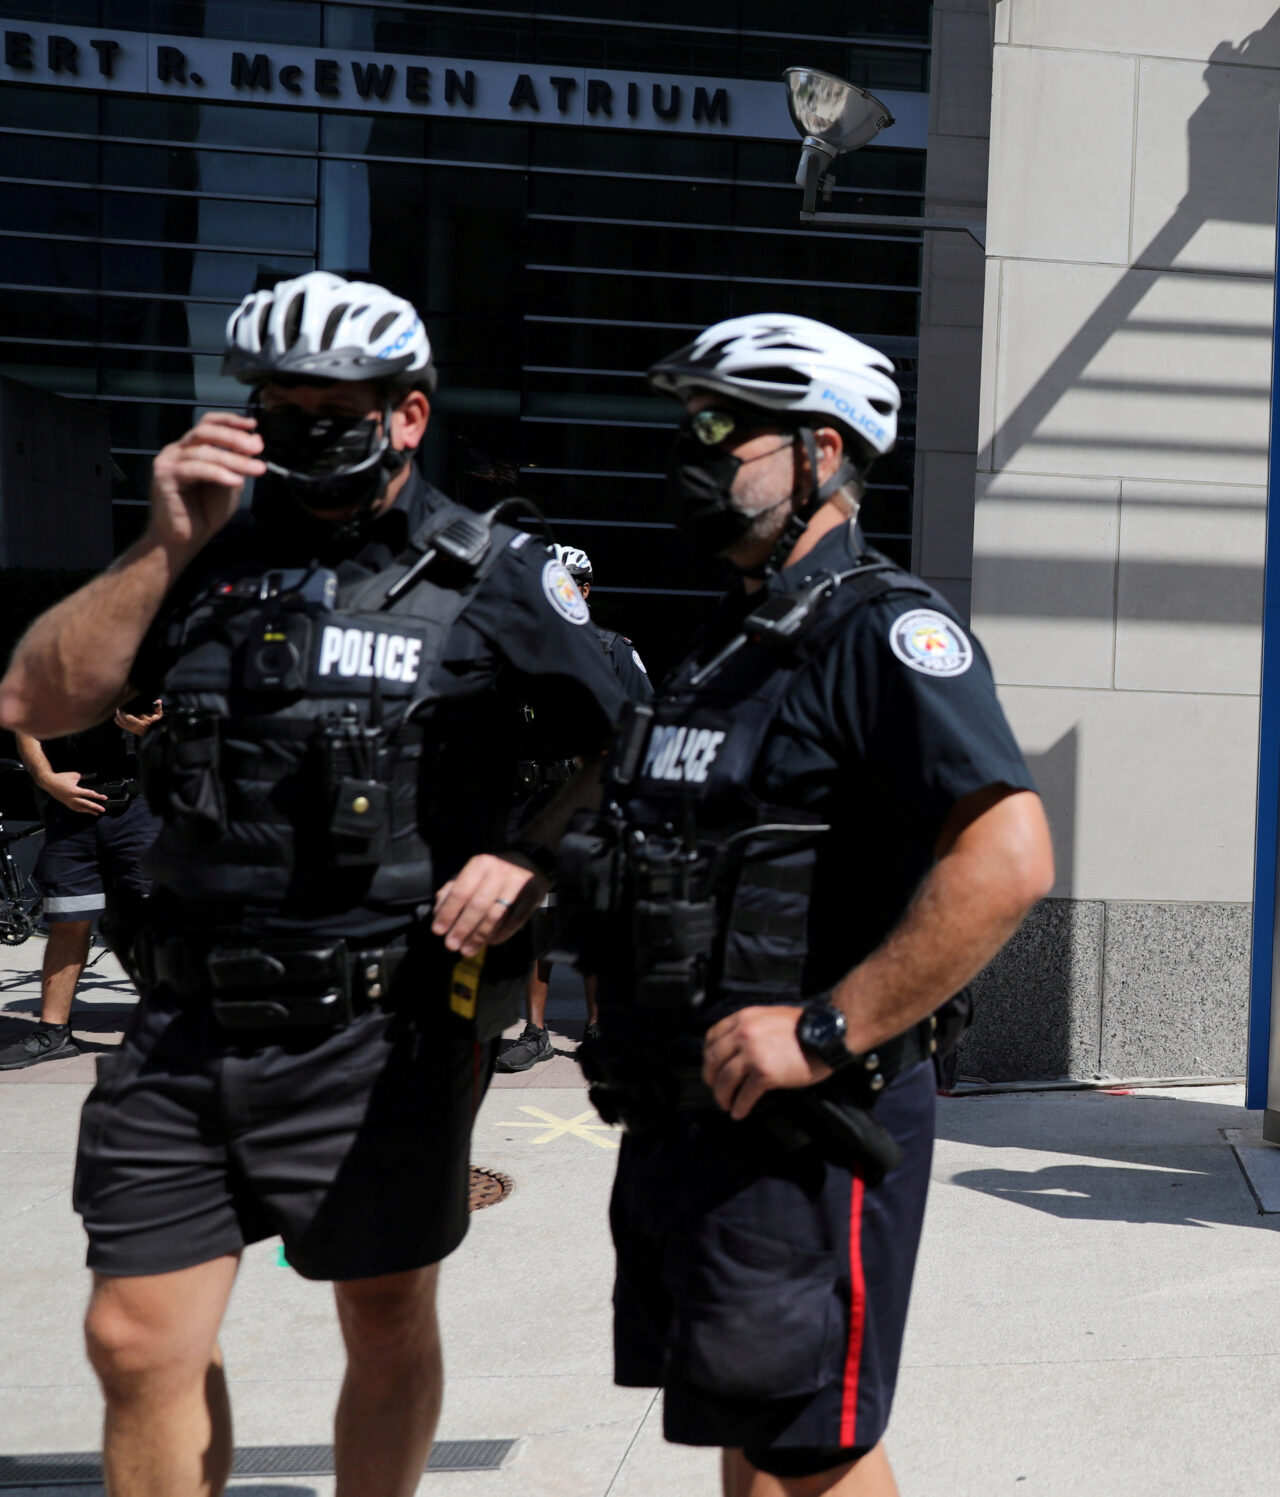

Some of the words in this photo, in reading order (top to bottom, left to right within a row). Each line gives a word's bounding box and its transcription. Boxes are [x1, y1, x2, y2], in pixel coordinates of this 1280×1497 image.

[5, 30, 119, 77] ERT
[157, 45, 203, 85] R.
[508, 73, 729, 123] ATRIUM
[822, 389, 885, 441] POLICE
[319, 625, 422, 683] POLICE
[642, 725, 725, 783] POLICE
